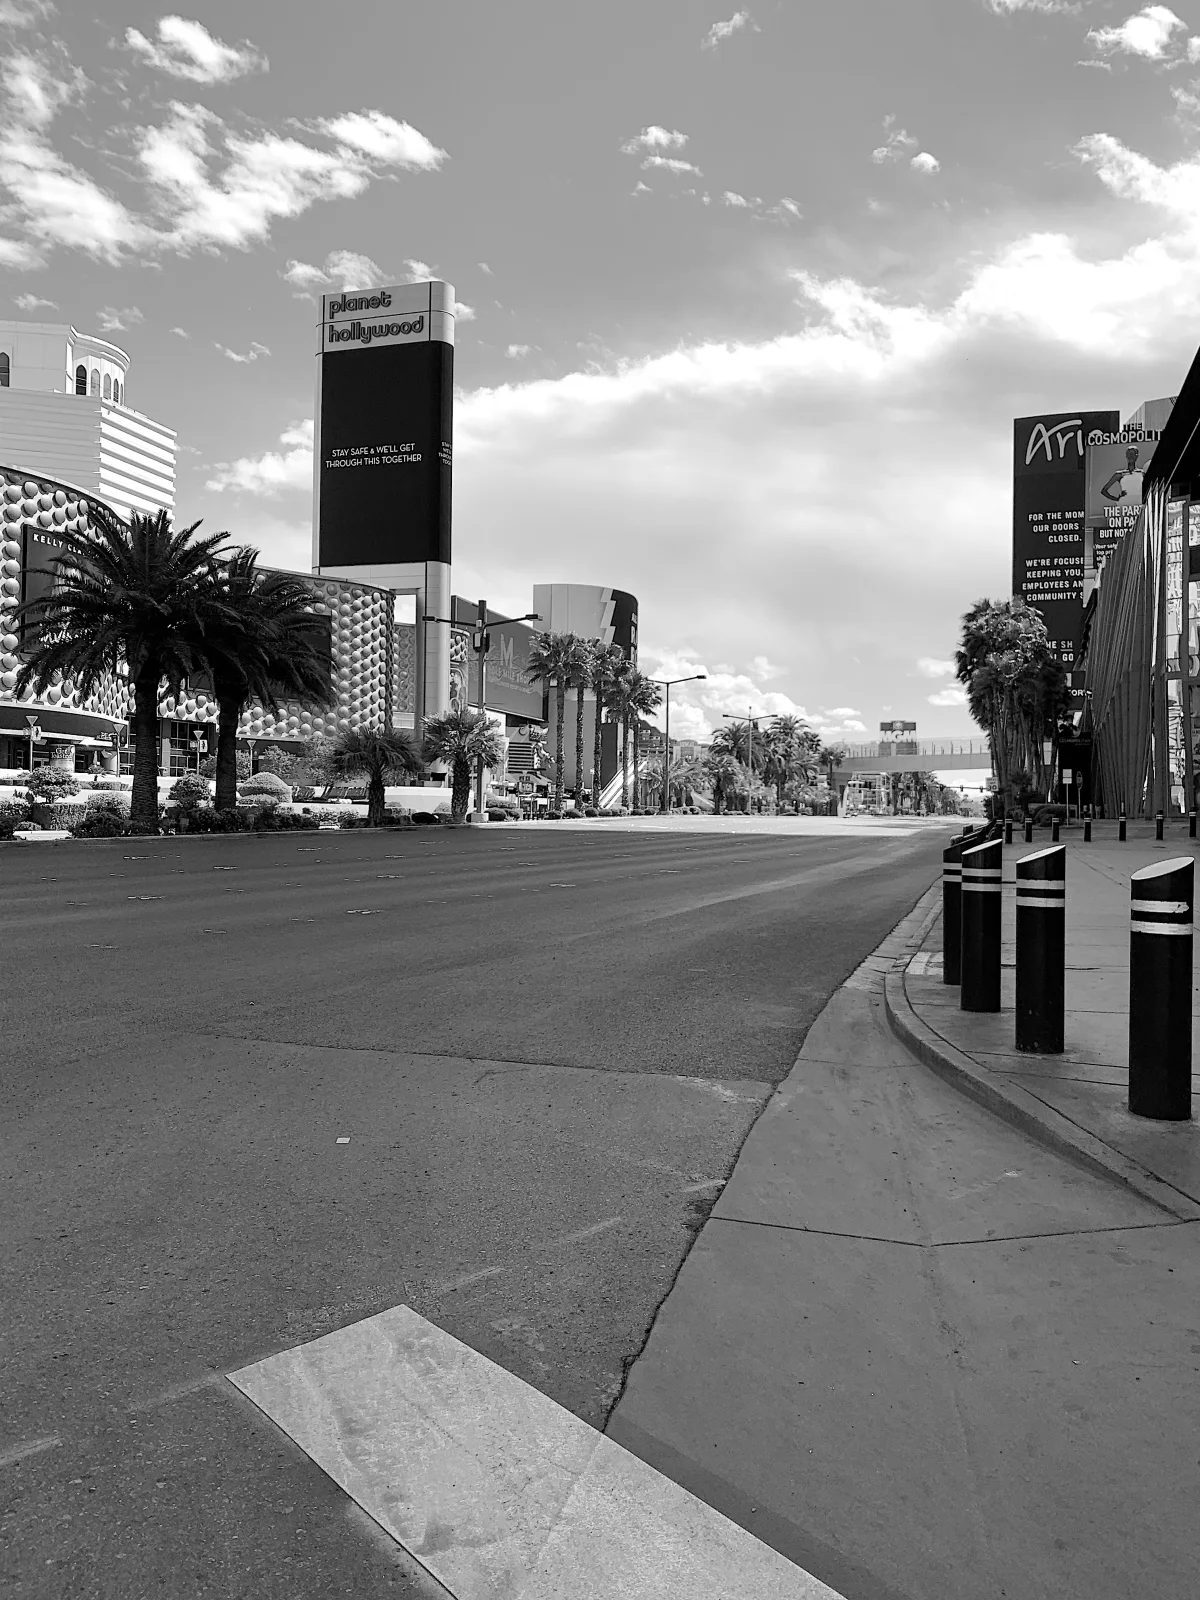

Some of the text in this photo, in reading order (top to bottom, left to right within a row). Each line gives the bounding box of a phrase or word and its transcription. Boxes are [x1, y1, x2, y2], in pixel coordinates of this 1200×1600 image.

[329, 291, 392, 319] planet
[329, 315, 424, 344] hollywood
[1123, 423, 1142, 431] THE
[1025, 419, 1103, 465] Ari
[332, 449, 349, 457] STAY
[350, 447, 369, 455] SAFE
[376, 445, 398, 454] WE'LL
[400, 443, 415, 452] GET
[326, 454, 422, 468] THROUGH THIS TOGETHER
[1046, 512, 1062, 520] THE
[1103, 507, 1121, 517] THE
[1109, 517, 1122, 528] ON
[1033, 523, 1079, 532] OUR DOORS
[1100, 529, 1113, 538] BUT
[33, 533, 63, 548] KELLY
[1048, 534, 1082, 543] CLOSED.
[1025, 559, 1051, 567] WE'RE
[1026, 570, 1061, 578] KEEPING
[1022, 581, 1070, 590] EMPLOYEES
[1026, 592, 1077, 601] COMMUNITY
[1062, 653, 1074, 661] GO
